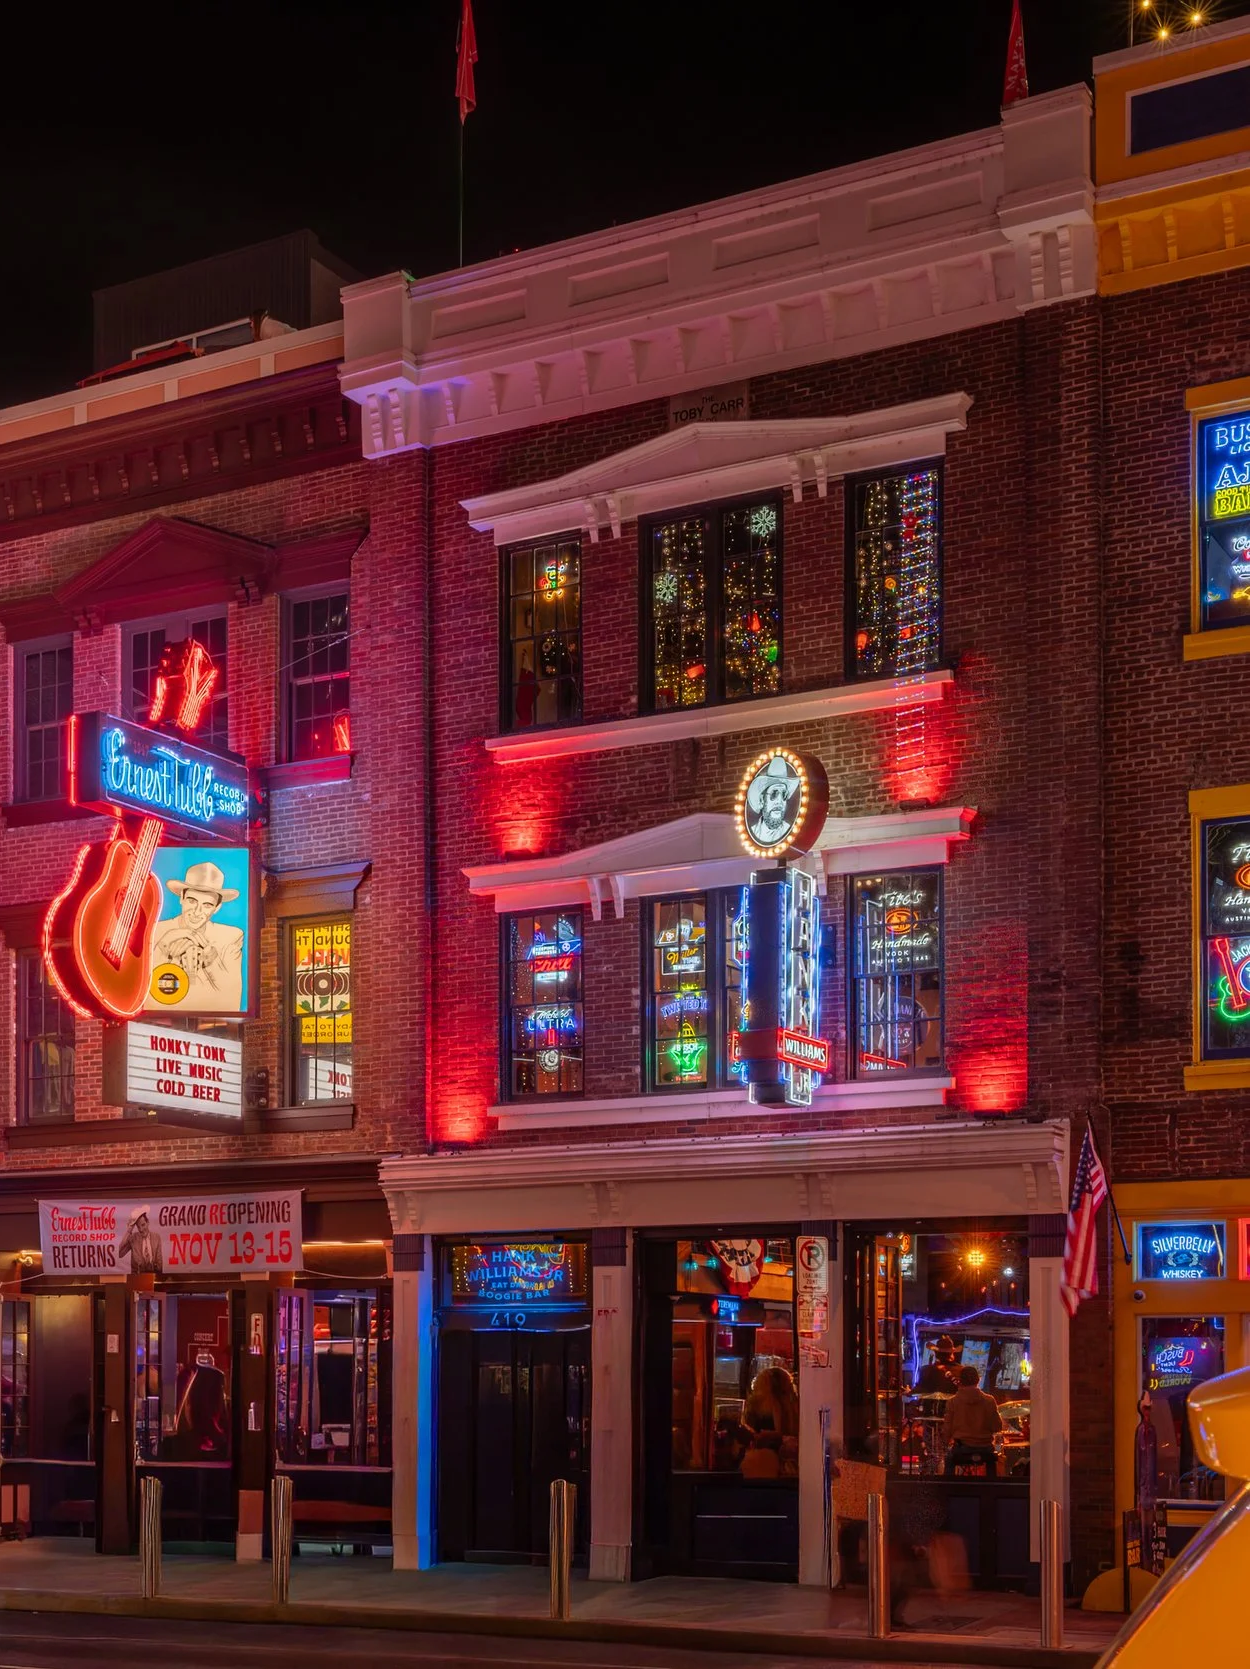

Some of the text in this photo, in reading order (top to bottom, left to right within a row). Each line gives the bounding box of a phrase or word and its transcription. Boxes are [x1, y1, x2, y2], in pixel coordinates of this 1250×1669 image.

[672, 398, 744, 424] TOBY CARR
[213, 782, 246, 803] RECORD
[218, 799, 244, 815] SHOP
[150, 1035, 227, 1063] HONKY TONK
[784, 1037, 826, 1064] WILLIAMS
[156, 1057, 223, 1082] LIVE MUSIC
[156, 1079, 221, 1102] COLD BEER
[51, 1206, 116, 1232] Ernest Tubb
[159, 1200, 291, 1227] GRAND REOPENING
[52, 1232, 115, 1242] RECORD SHOP
[169, 1230, 293, 1265] NOV 13-15
[1152, 1235, 1216, 1254] SILVERBELLY
[53, 1245, 115, 1269] RETURNS
[492, 1251, 535, 1263] HANK
[466, 1266, 564, 1282] WILLIAMS JR
[1162, 1269, 1204, 1279] WHISKEY
[478, 1289, 551, 1300] BOOGIE BAR
[491, 1312, 526, 1326] 419
